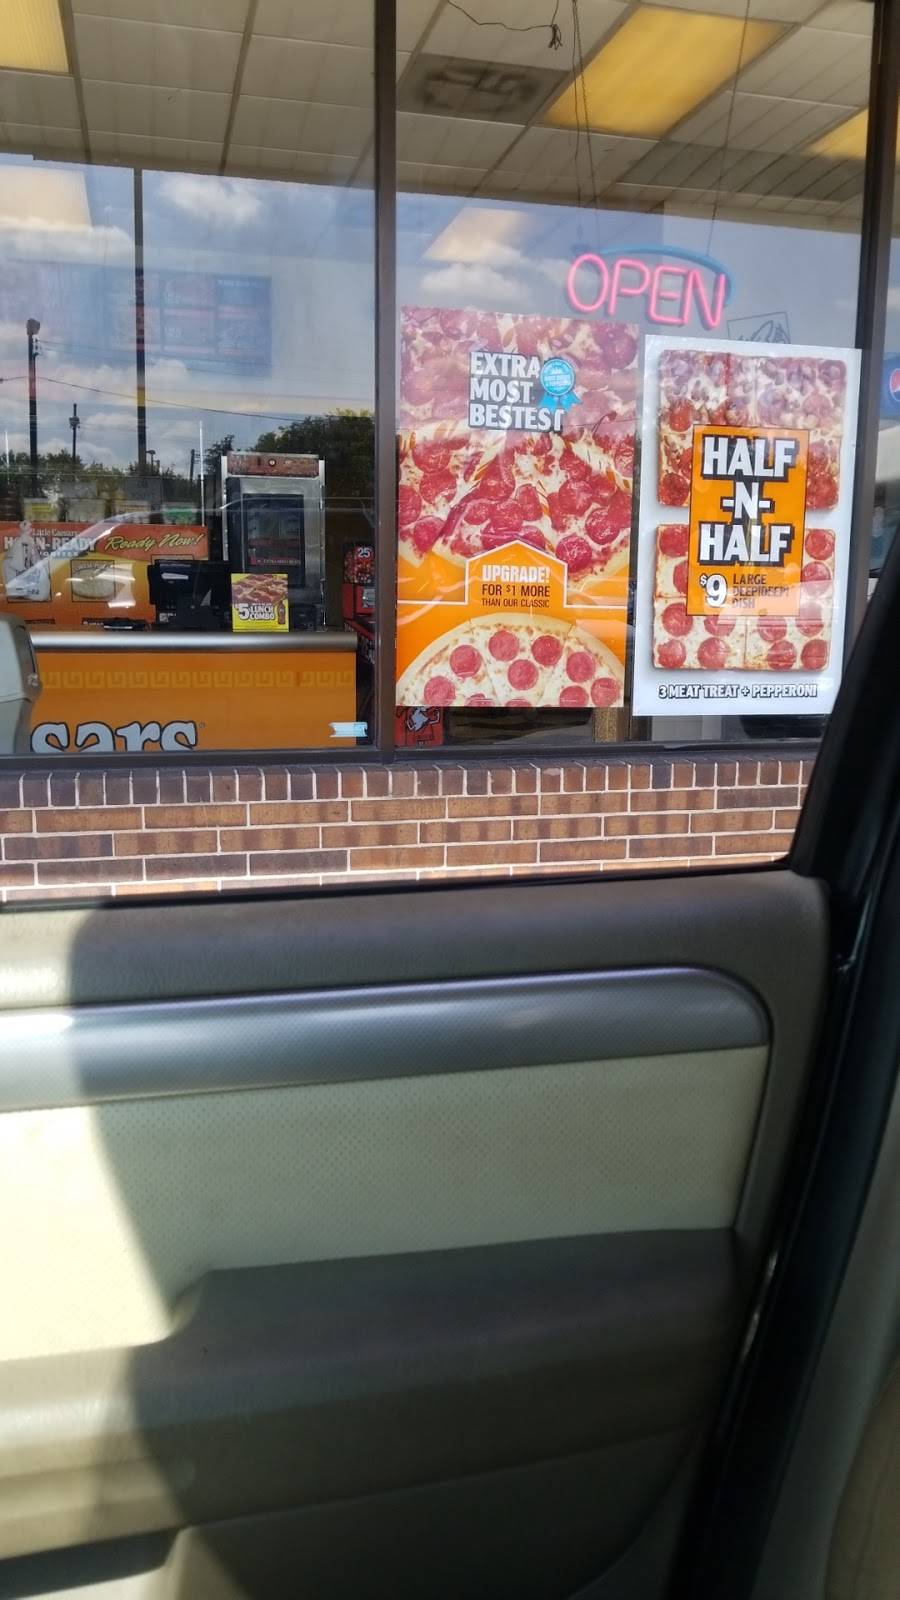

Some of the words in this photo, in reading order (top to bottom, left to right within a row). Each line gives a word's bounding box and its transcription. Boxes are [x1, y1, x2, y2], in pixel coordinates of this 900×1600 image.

[567, 253, 726, 328] OPEN
[470, 351, 541, 379] EXTRA
[470, 377, 534, 404] MOST
[469, 403, 566, 432] BESTEST
[702, 436, 797, 479] HALF
[722, 481, 773, 520] -N-
[105, 535, 156, 552] Ready
[158, 533, 205, 548] Now!
[357, 546, 371, 559] 25
[699, 523, 792, 564] HALF
[482, 564, 551, 584] UPGRADE!
[732, 573, 767, 585] LARGE
[482, 584, 502, 596] FOR
[506, 584, 516, 596] $1
[521, 585, 551, 598] MORE
[699, 572, 728, 609] $9
[481, 597, 501, 607] THAN
[503, 598, 518, 608] OUR
[520, 598, 550, 609] CLASSIC
[731, 597, 755, 609] DISH
[250, 611, 275, 620] COMBO
[658, 684, 668, 699] 3
[668, 684, 701, 699] MEAT
[702, 684, 740, 699] TREAT
[741, 685, 750, 697] +
[751, 683, 818, 698] PEPPERONI
